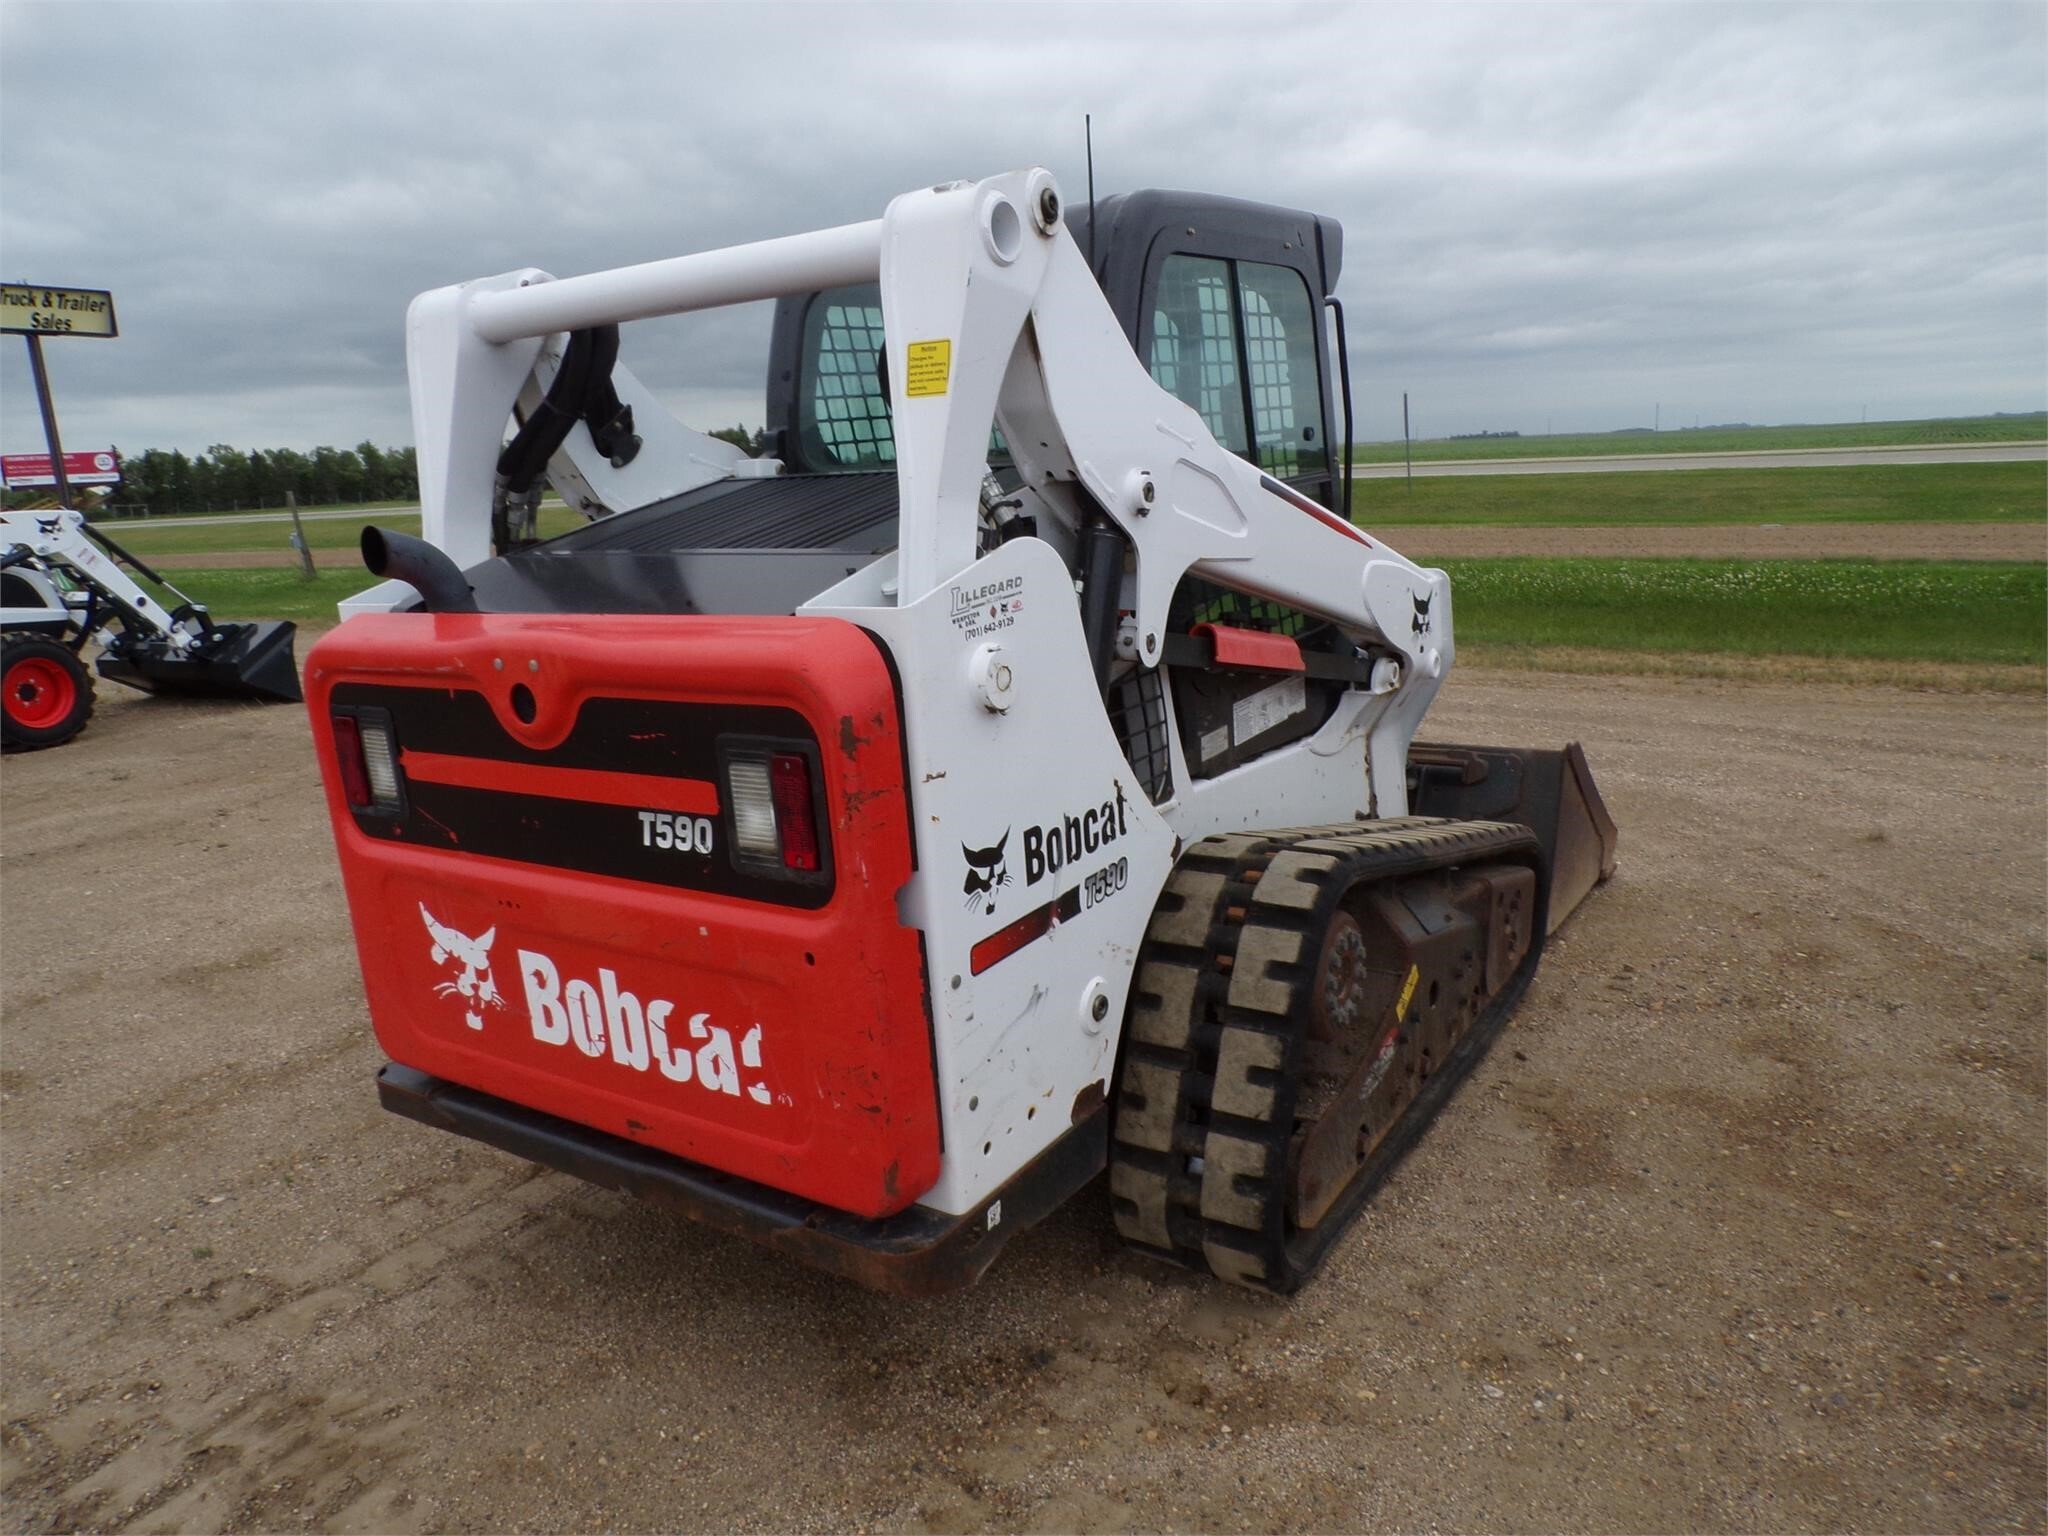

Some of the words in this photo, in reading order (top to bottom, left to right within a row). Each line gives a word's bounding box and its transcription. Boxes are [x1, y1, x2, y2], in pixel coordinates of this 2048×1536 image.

[0, 288, 36, 307] Truck
[42, 291, 52, 308] &
[57, 293, 106, 312] Trailer
[31, 312, 72, 330] Sales
[951, 576, 1022, 617] LILLEGARD
[965, 627, 983, 641] (701)
[983, 616, 1014, 634] 642-9129
[638, 811, 713, 854] T590
[1023, 779, 1127, 887] Bobcat
[1084, 856, 1128, 909] T590
